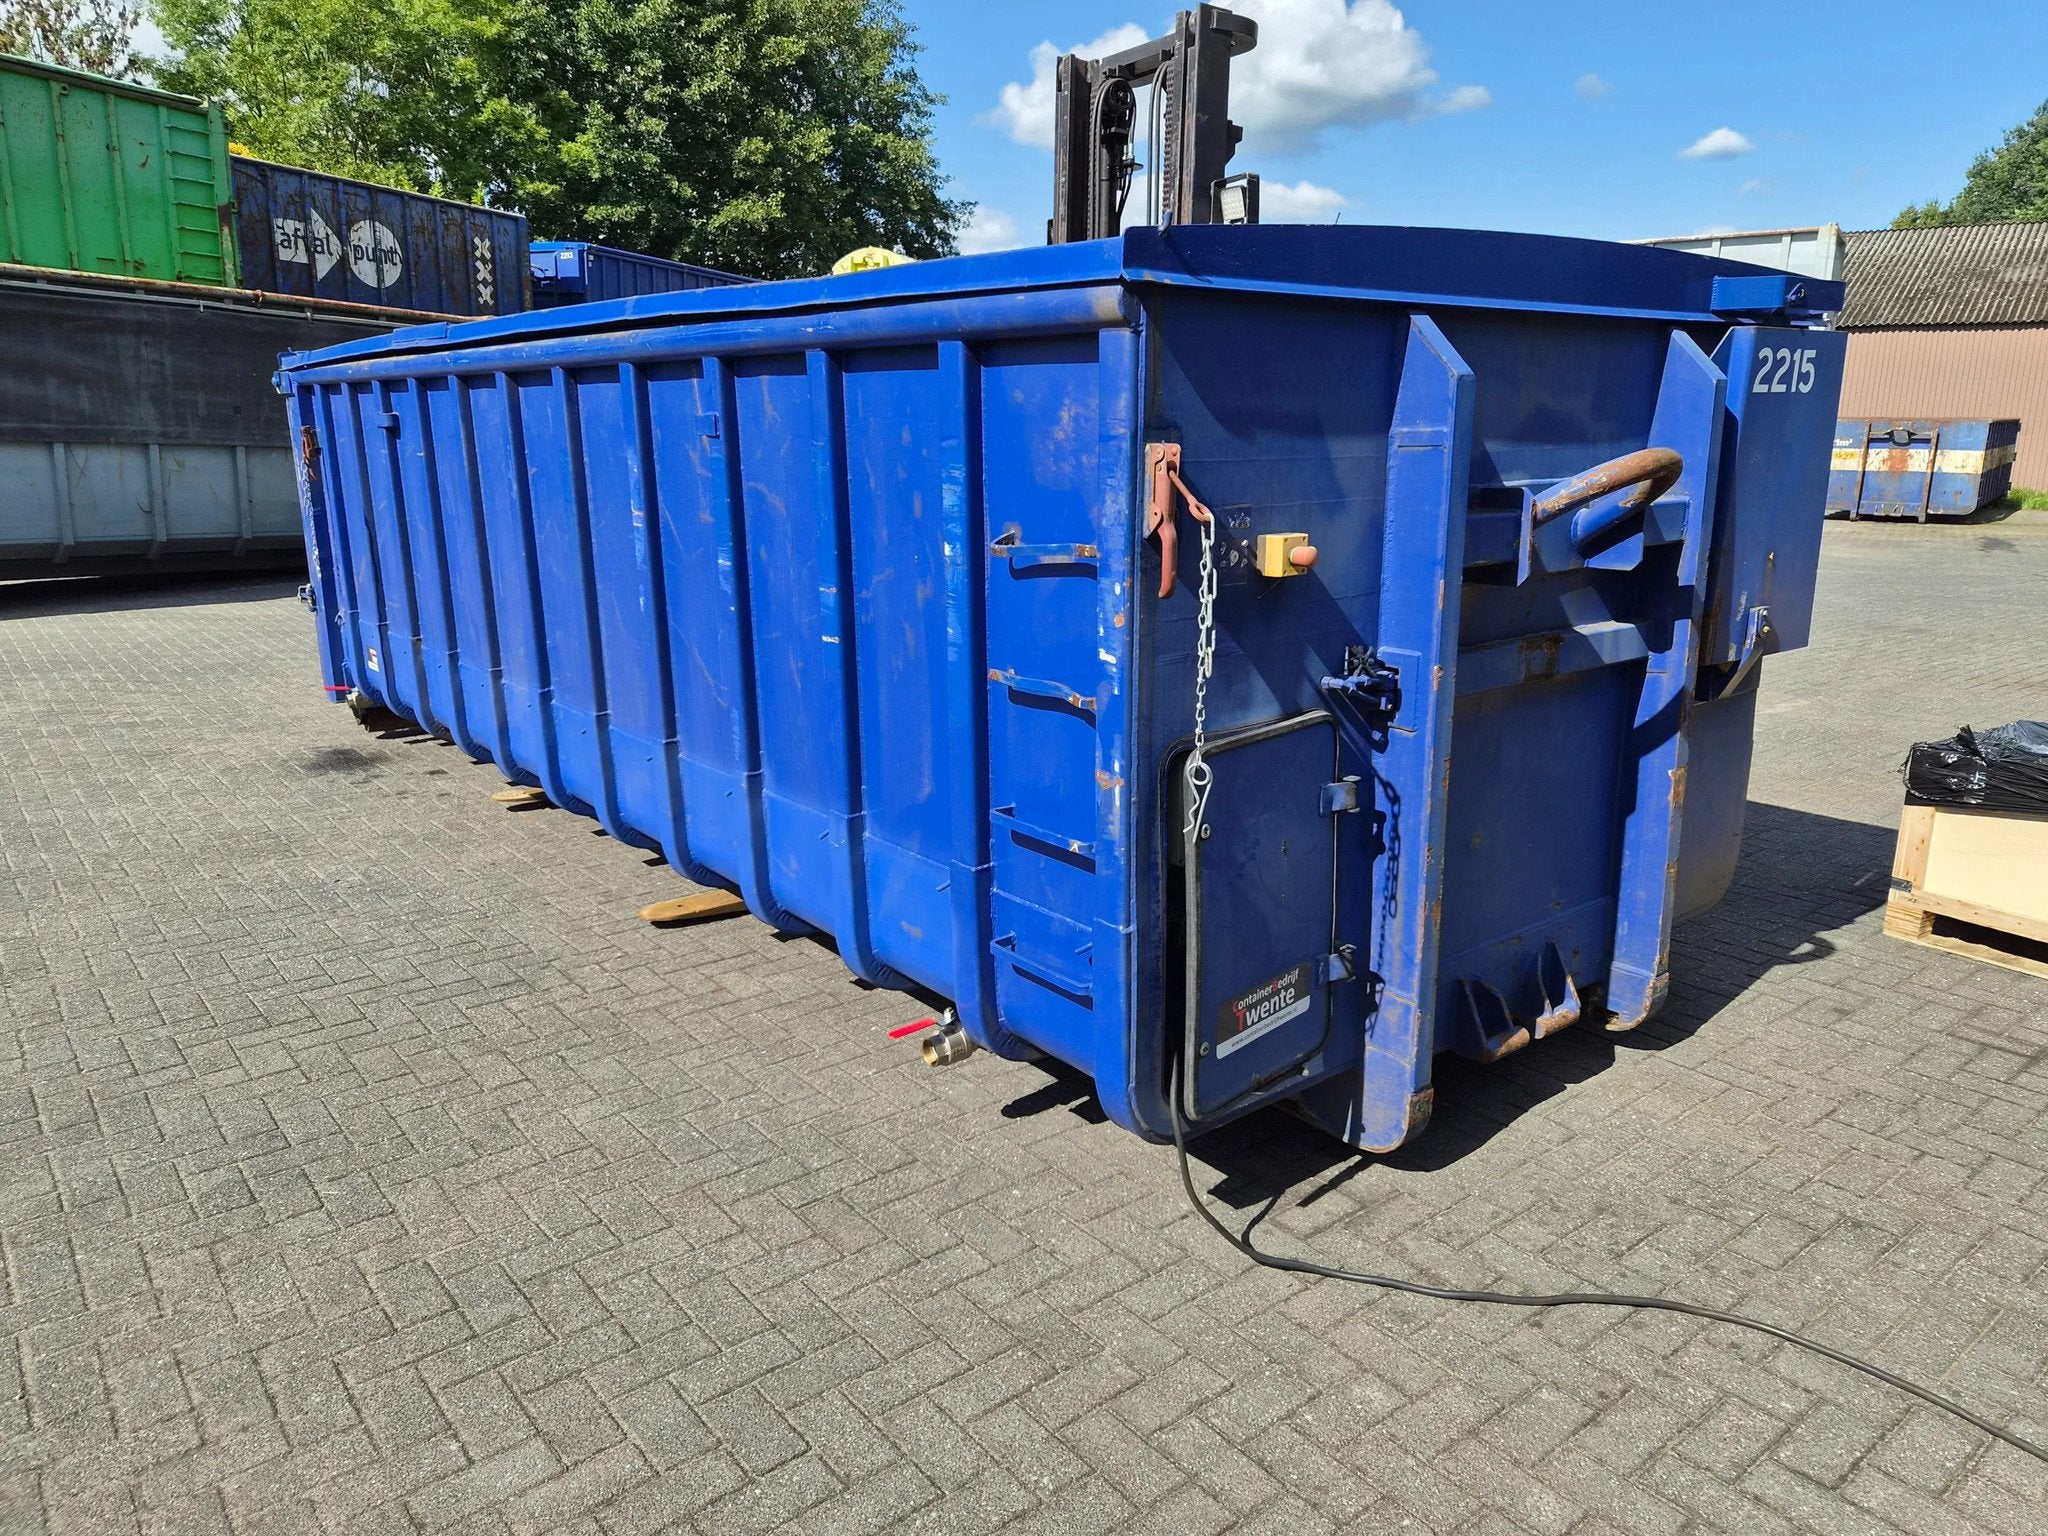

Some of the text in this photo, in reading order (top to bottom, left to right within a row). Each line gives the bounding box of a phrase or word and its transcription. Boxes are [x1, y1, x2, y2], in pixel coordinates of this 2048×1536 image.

[353, 243, 399, 267] punt
[1752, 347, 1817, 393] 2215
[1833, 438, 1853, 447] 1m³
[1235, 987, 1295, 1031] Twente
